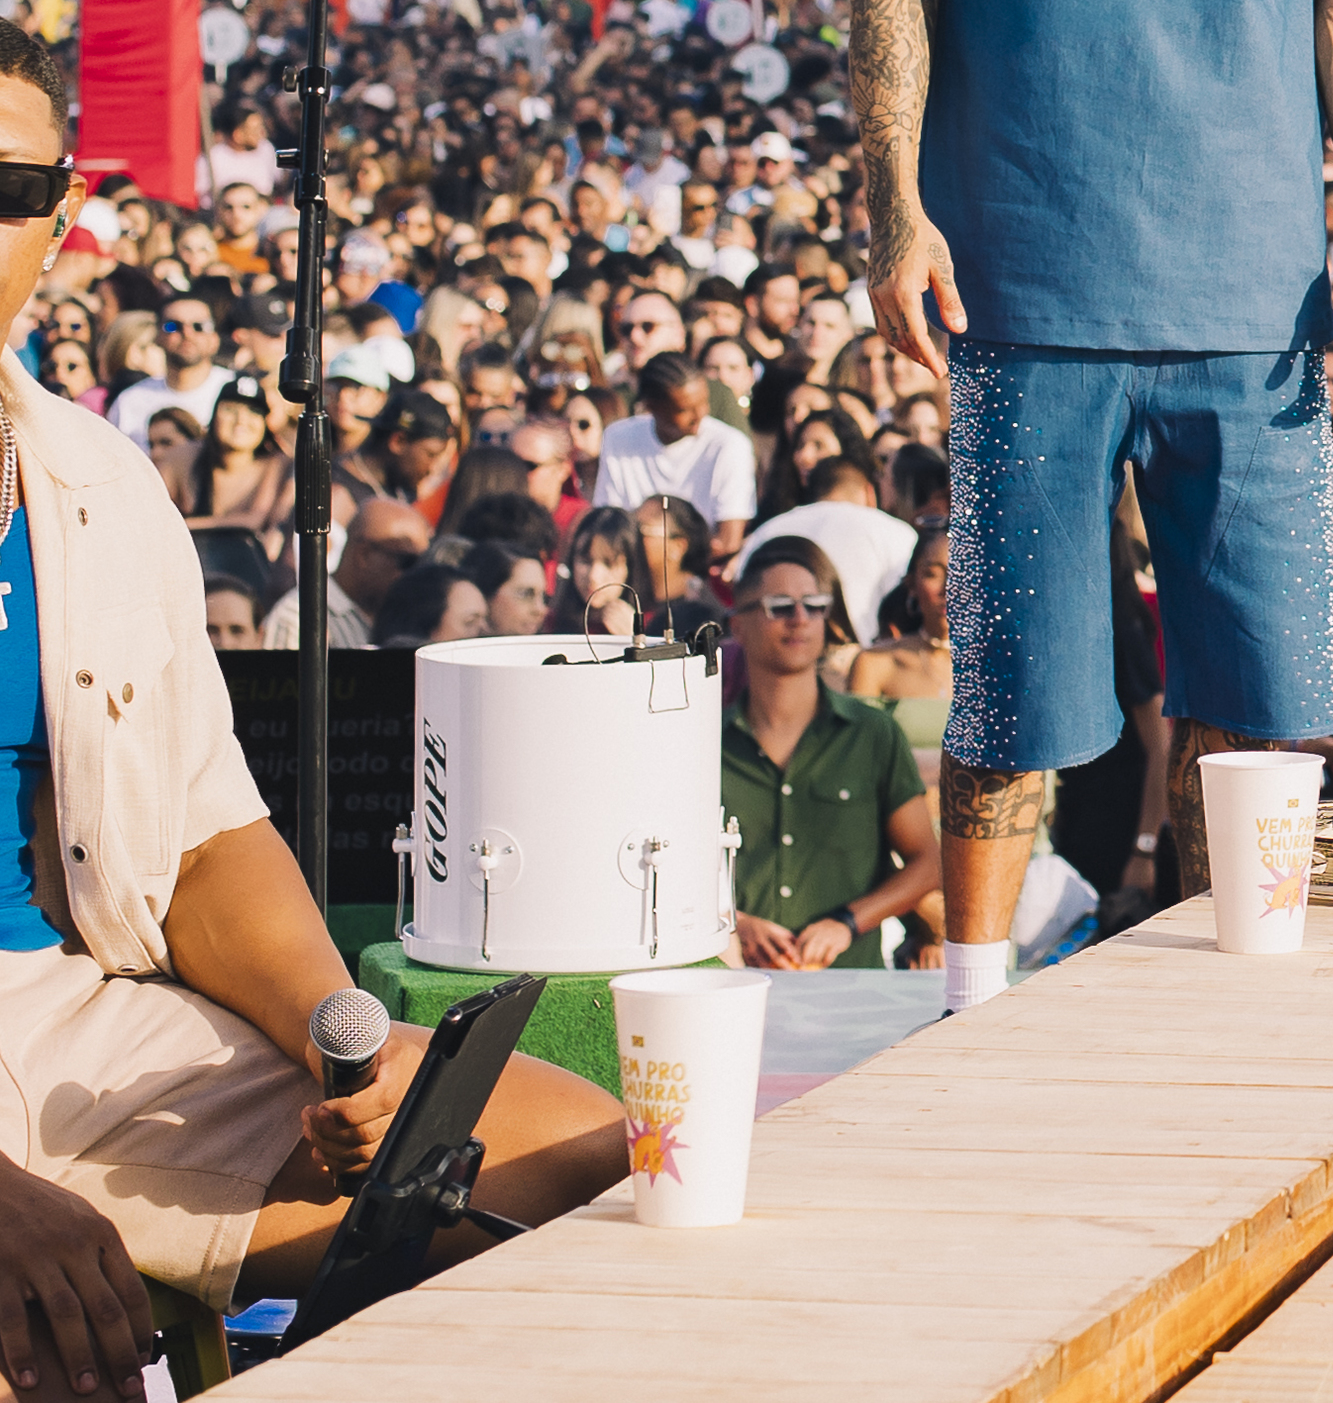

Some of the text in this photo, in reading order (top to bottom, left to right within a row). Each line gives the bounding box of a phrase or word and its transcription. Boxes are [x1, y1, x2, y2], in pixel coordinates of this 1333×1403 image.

[423, 717, 448, 883] GOPE
[1256, 817, 1292, 834] VEM
[621, 1056, 686, 1082] EM PRO
[623, 1077, 690, 1104] HURRAS
